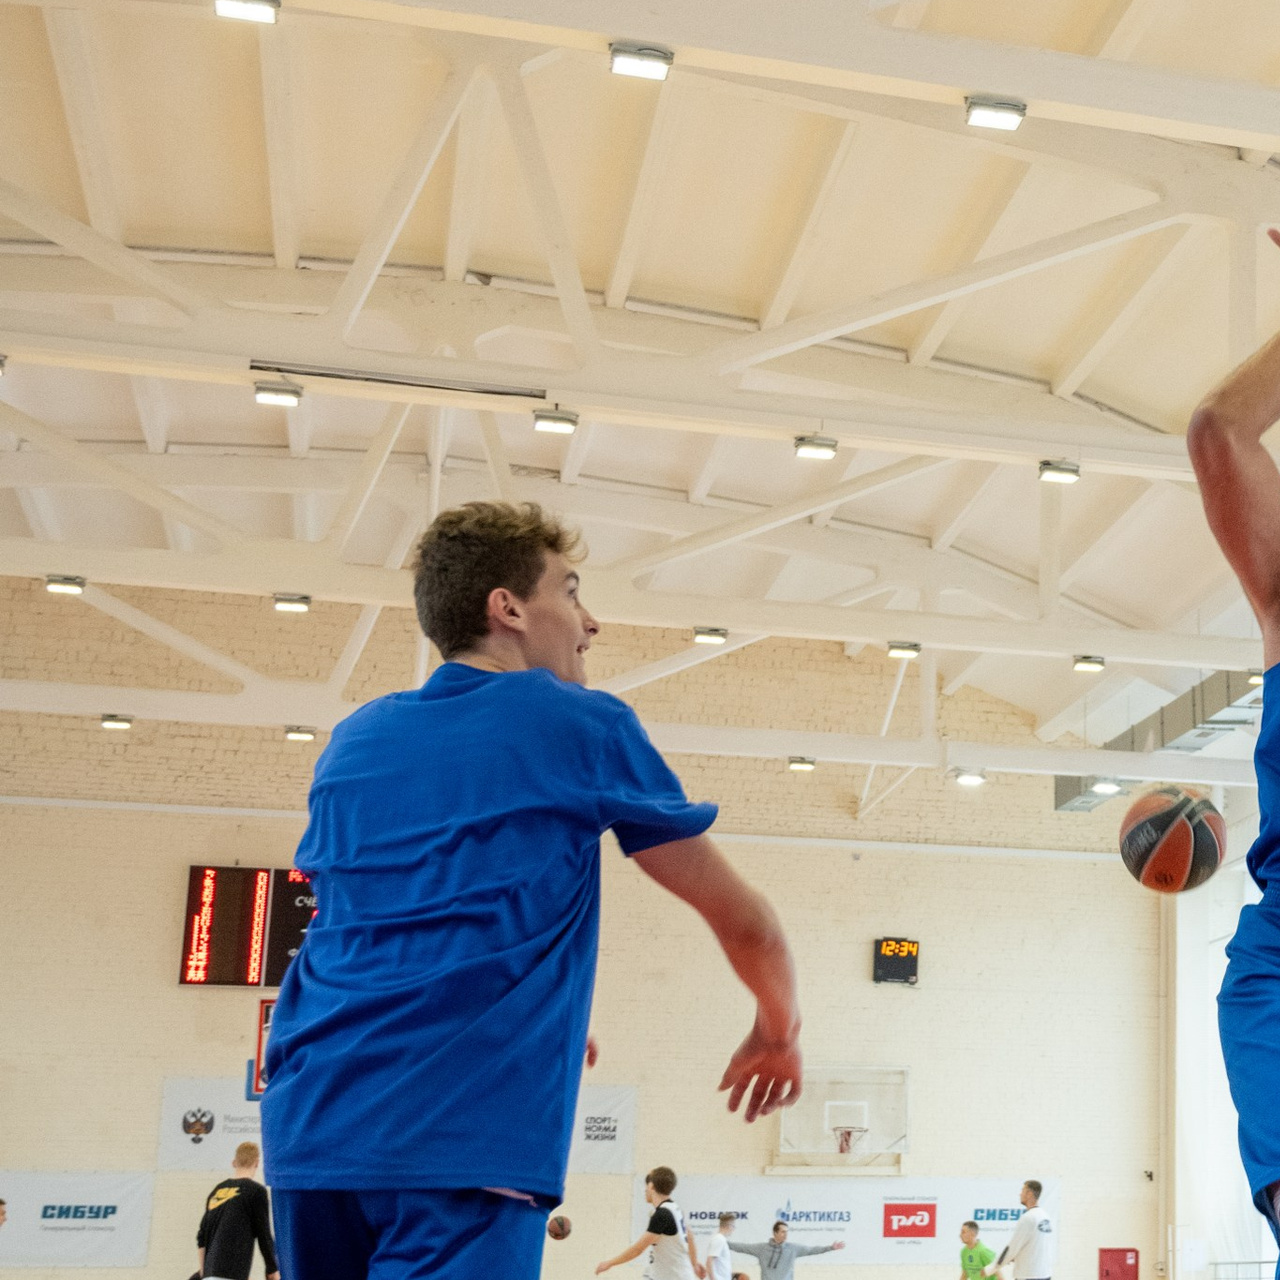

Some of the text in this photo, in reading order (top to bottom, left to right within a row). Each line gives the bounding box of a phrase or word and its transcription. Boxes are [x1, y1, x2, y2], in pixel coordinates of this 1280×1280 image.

[294, 895, 319, 907] СЧЕ
[881, 940, 918, 957] 12:34
[584, 1125, 617, 1133] НОРМА
[41, 1205, 118, 1219] СИБУР
[792, 1211, 851, 1222] АРКТИКГАЗ
